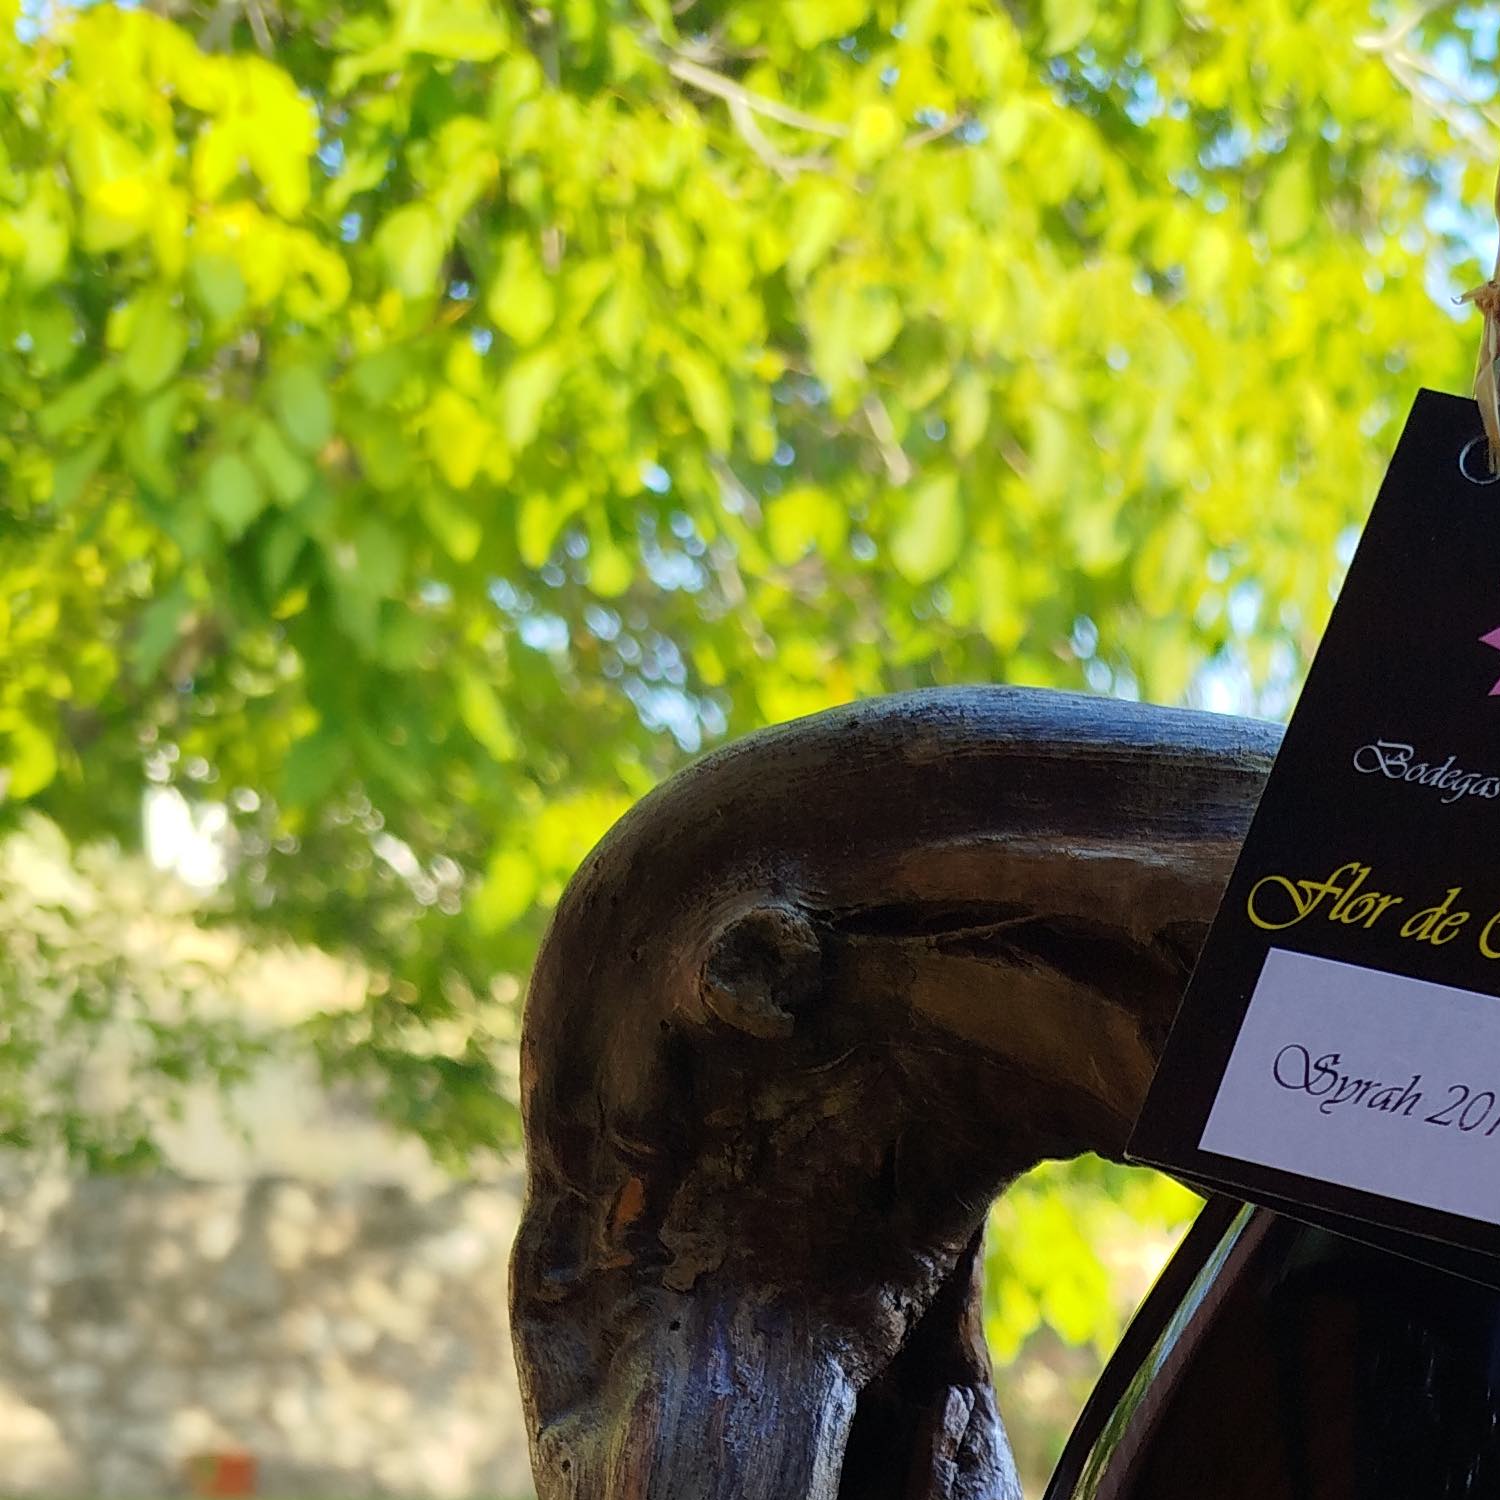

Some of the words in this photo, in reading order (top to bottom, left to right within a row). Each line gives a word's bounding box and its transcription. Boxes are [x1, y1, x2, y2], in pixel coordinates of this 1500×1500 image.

[1247, 863, 1401, 933] Flor
[1401, 886, 1470, 947] de
[1273, 1044, 1422, 1118] Syrah
